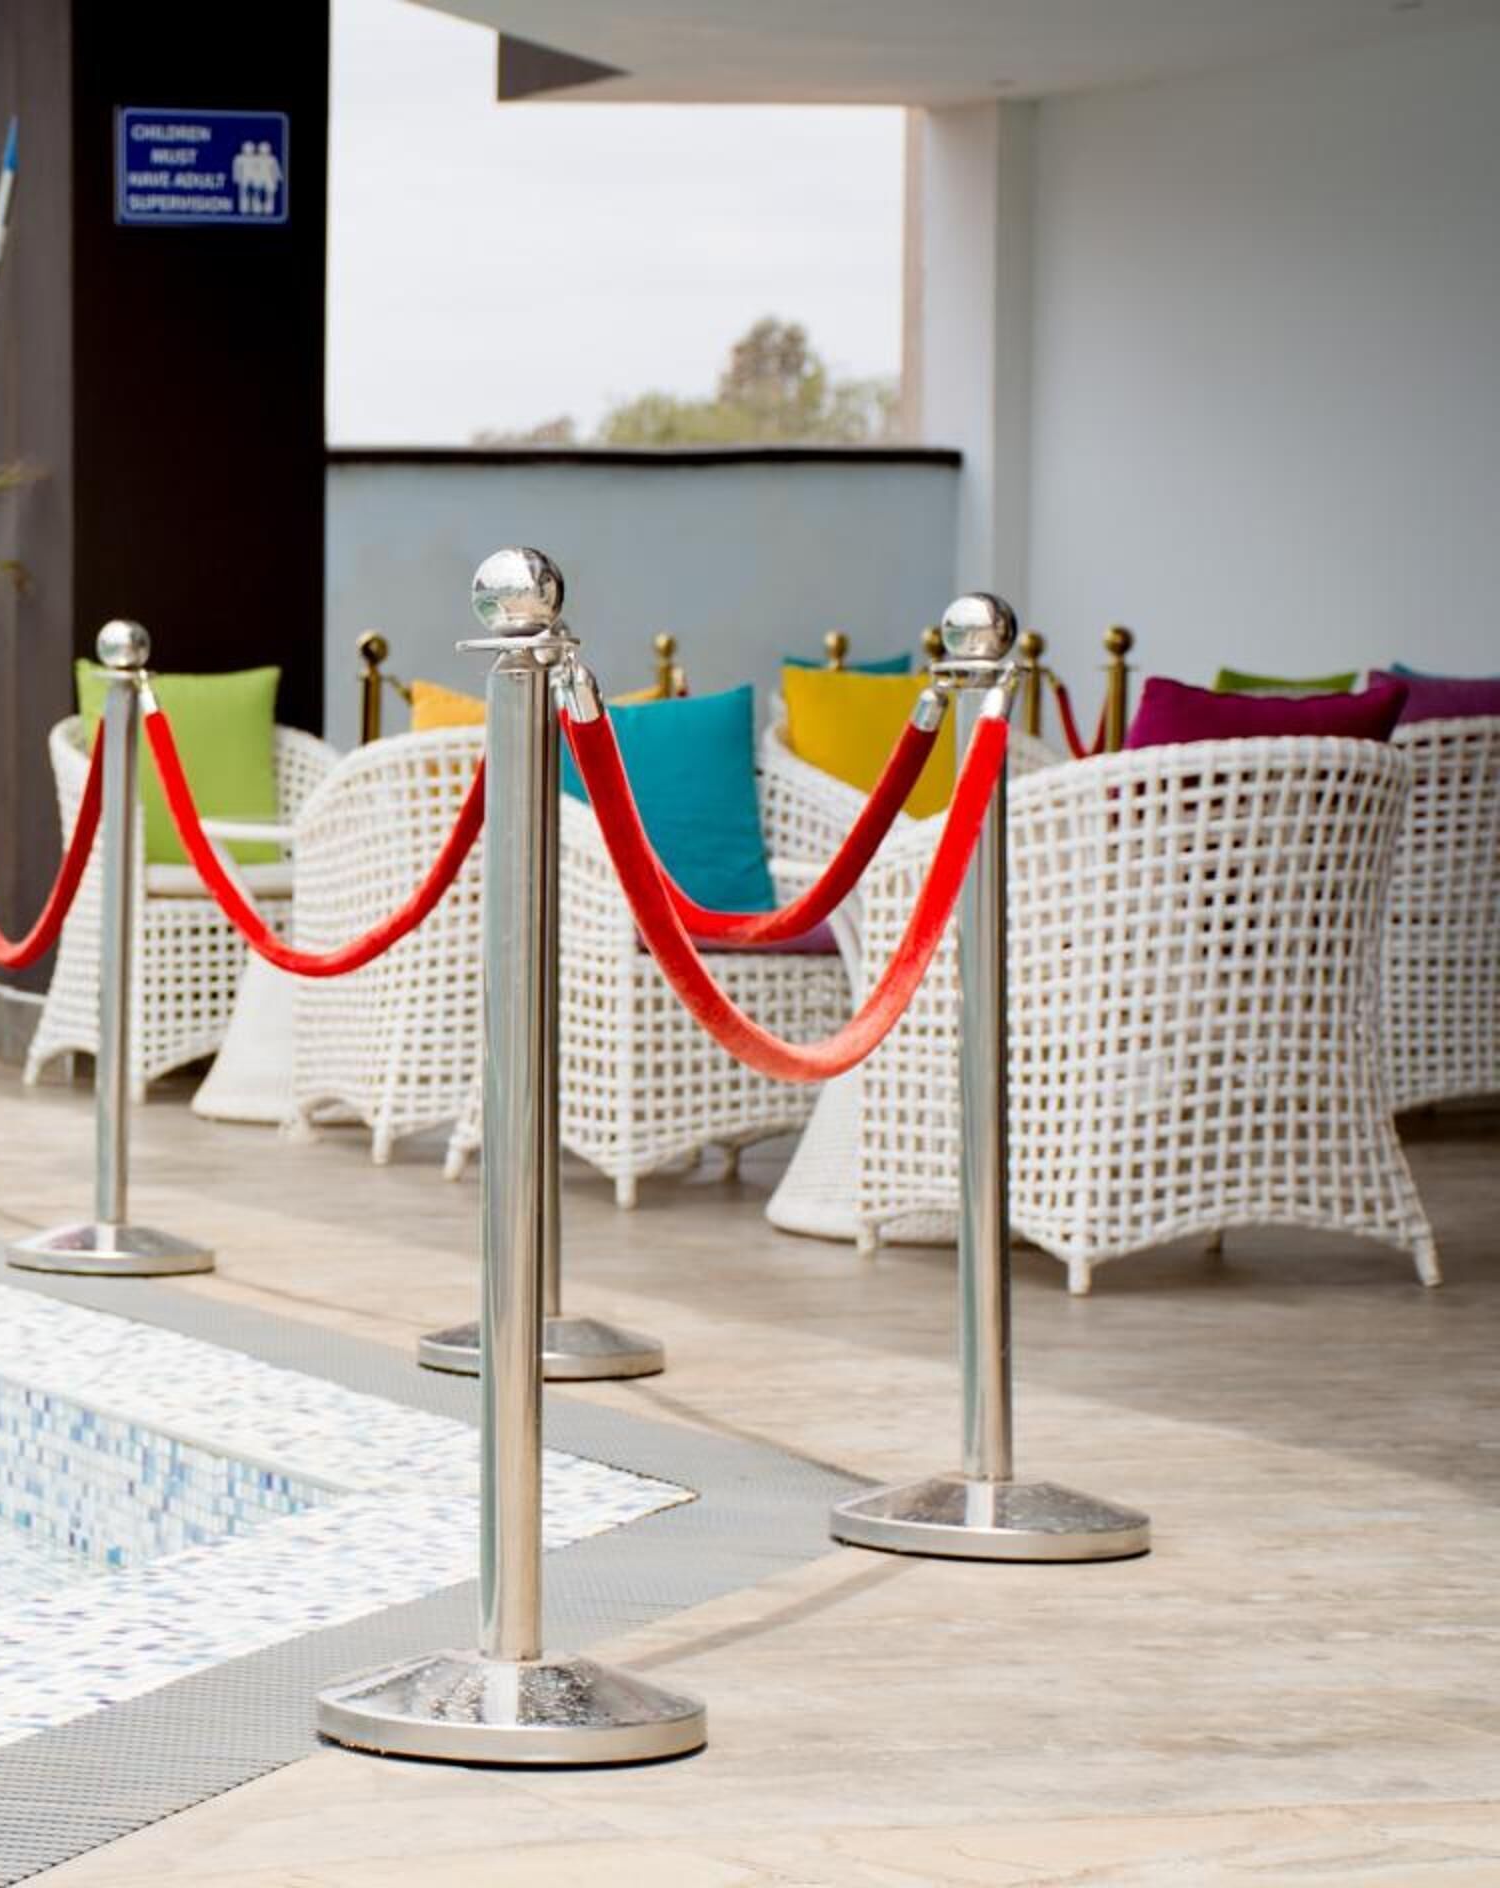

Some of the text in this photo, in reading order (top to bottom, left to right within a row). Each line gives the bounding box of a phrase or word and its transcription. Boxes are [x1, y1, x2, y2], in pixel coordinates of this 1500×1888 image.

[131, 124, 212, 142] CHILDREN
[150, 149, 198, 164] MUST
[128, 171, 226, 189] HAVE ADULT
[129, 194, 233, 212] SUPERVISION
